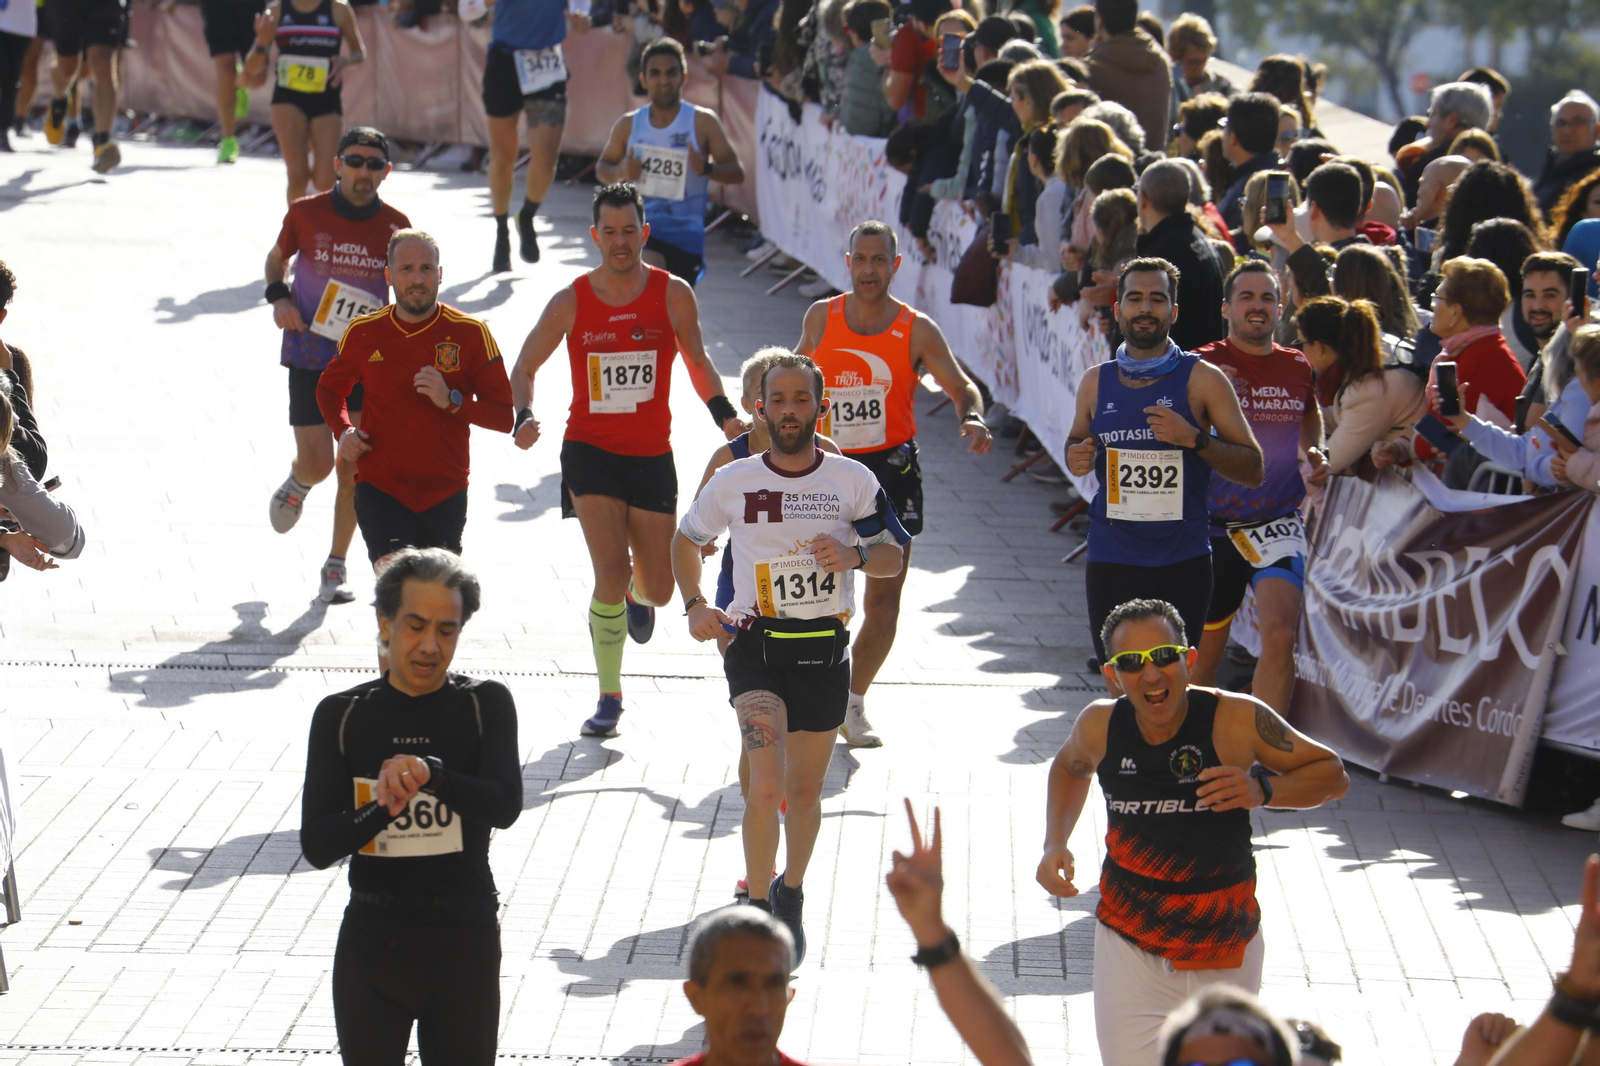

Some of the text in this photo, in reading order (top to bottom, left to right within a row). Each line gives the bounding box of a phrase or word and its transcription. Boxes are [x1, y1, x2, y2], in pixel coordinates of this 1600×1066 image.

[297, 65, 316, 80] 78
[641, 156, 683, 177] 4283
[333, 242, 369, 257] MEDIA
[314, 249, 386, 269] 36 MARATÓN
[602, 364, 653, 386] 1878
[1251, 386, 1290, 399] MEDIA
[832, 399, 881, 422] 1348
[1099, 428, 1154, 444] TROTASIE
[1127, 452, 1157, 460] IMDECO
[1119, 464, 1178, 489] 2392
[783, 501, 840, 513] MARATÓN
[784, 493, 840, 503] 35 MEDIA
[1249, 522, 1303, 544] 1402
[780, 558, 814, 569] IMDECO
[774, 571, 836, 601] 1314
[760, 585, 770, 609] CAJÓN
[394, 801, 455, 831] 360
[1108, 799, 1210, 815] JARTIBLE
